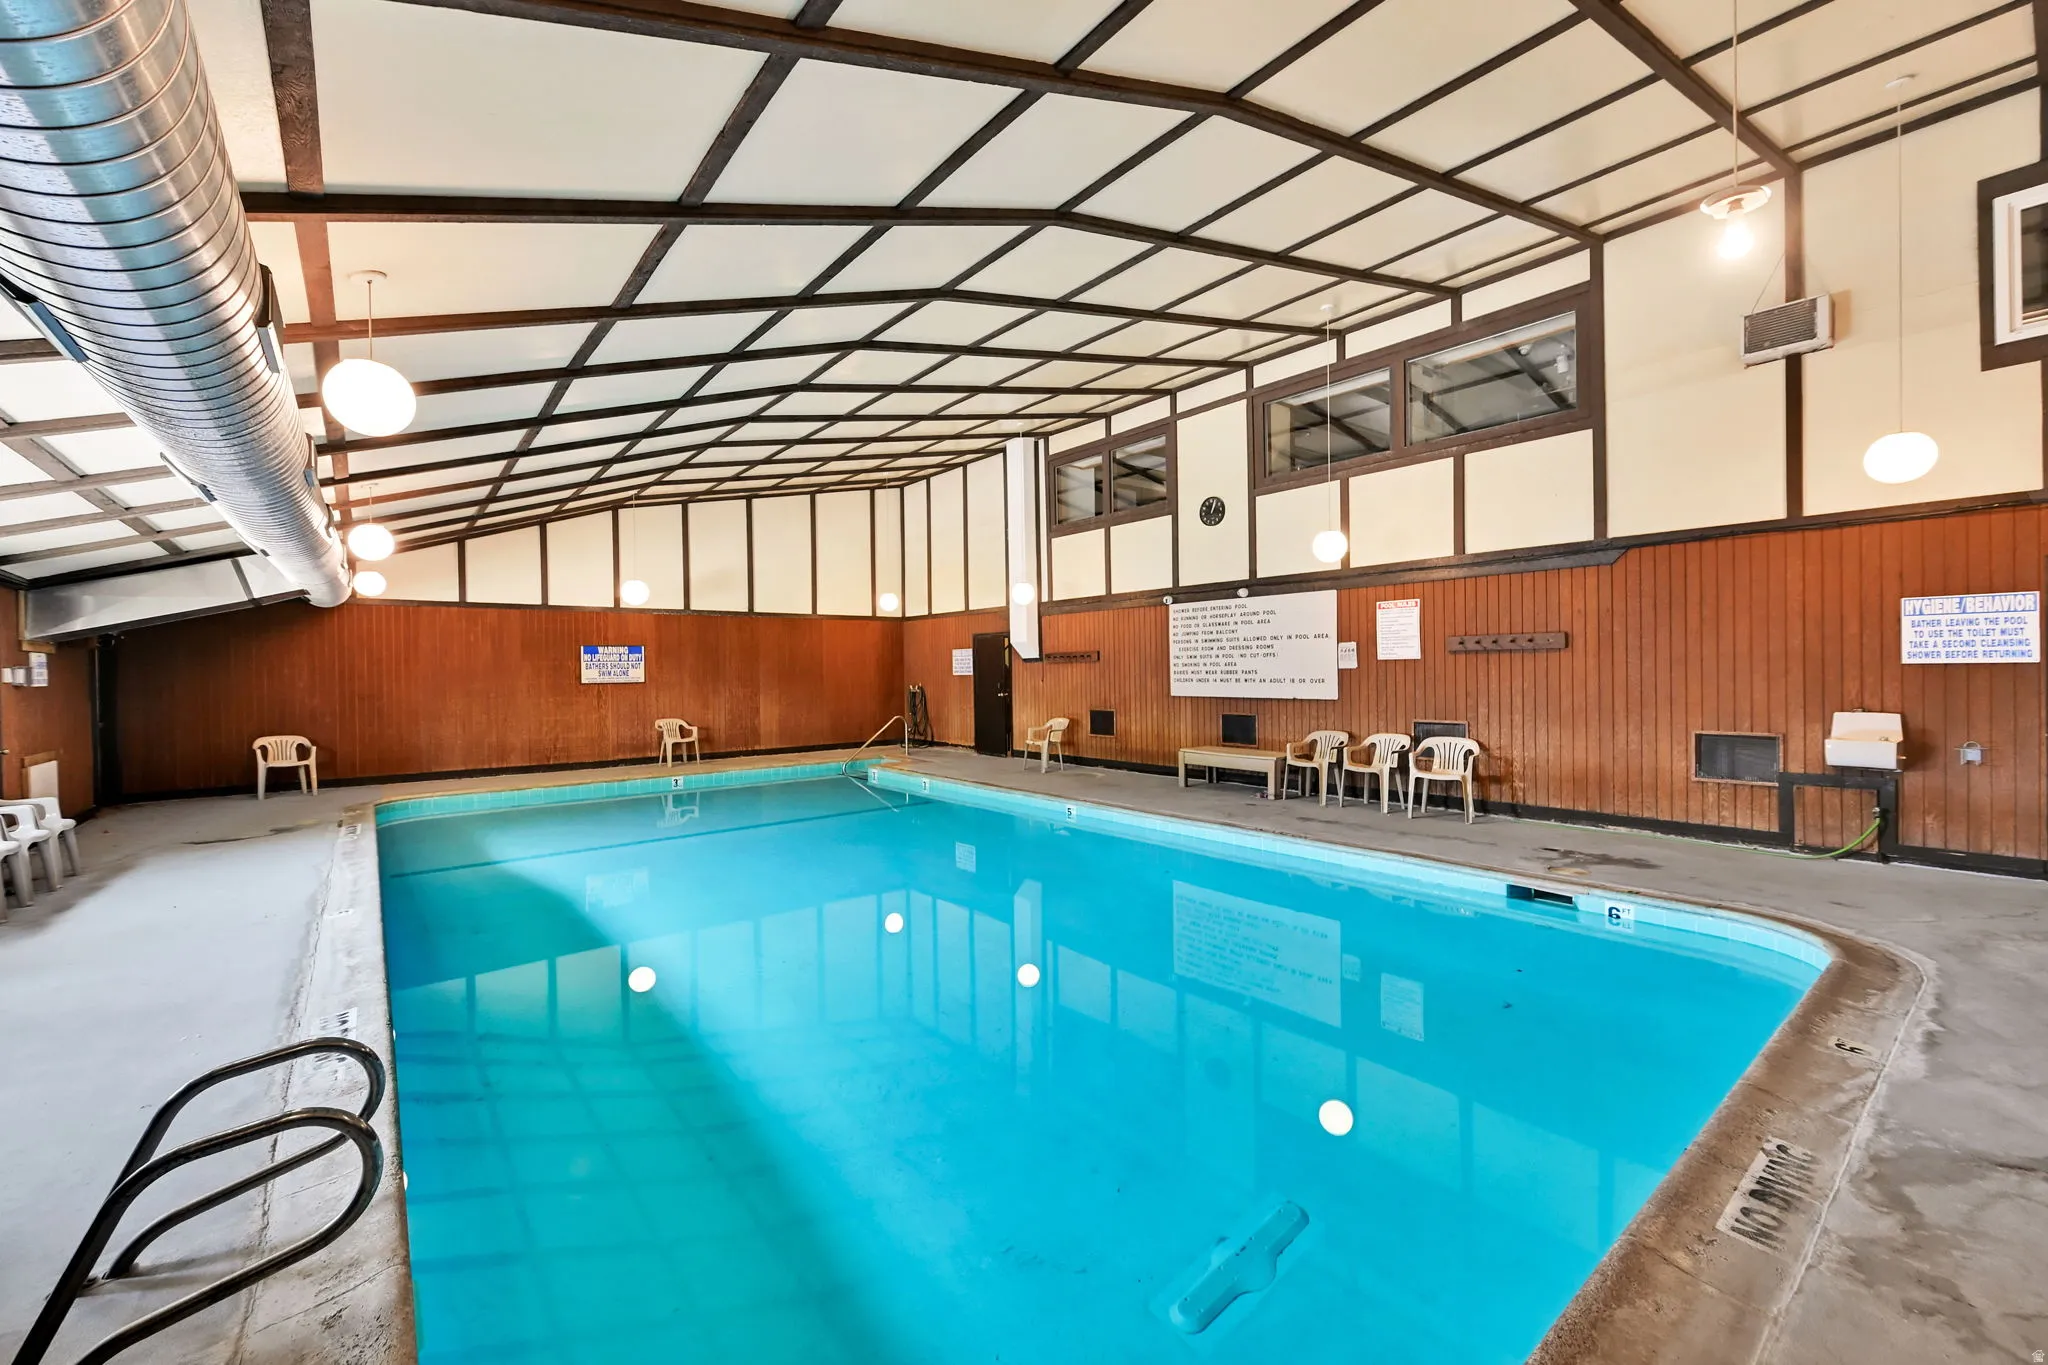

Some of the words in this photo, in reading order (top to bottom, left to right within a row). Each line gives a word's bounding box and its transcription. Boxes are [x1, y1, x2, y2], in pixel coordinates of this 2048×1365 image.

[1912, 618, 1942, 628] BATHER
[1946, 618, 1980, 627] LEAVING
[1984, 617, 2000, 626] THE
[2004, 616, 2028, 625] POOL
[1914, 630, 1924, 638] TO
[1928, 629, 1944, 638] USE
[1948, 629, 1962, 637] THE
[1967, 628, 1996, 637] TOILET
[2000, 627, 2025, 636] MUST
[1909, 640, 1929, 648] TAKE
[1933, 640, 1938, 648] A
[1942, 640, 1976, 648] SECOND
[1981, 638, 2031, 647] CLEANSING
[598, 646, 628, 654] WARNING
[1907, 650, 1941, 659] SHOWER
[1945, 650, 1978, 658] BEFORE
[1982, 649, 2033, 658] RETURNING
[1608, 906, 1621, 919] 6
[1622, 908, 1631, 917] FT
[1749, 1144, 1820, 1212] DIVING
[1730, 1206, 1788, 1251] NO
